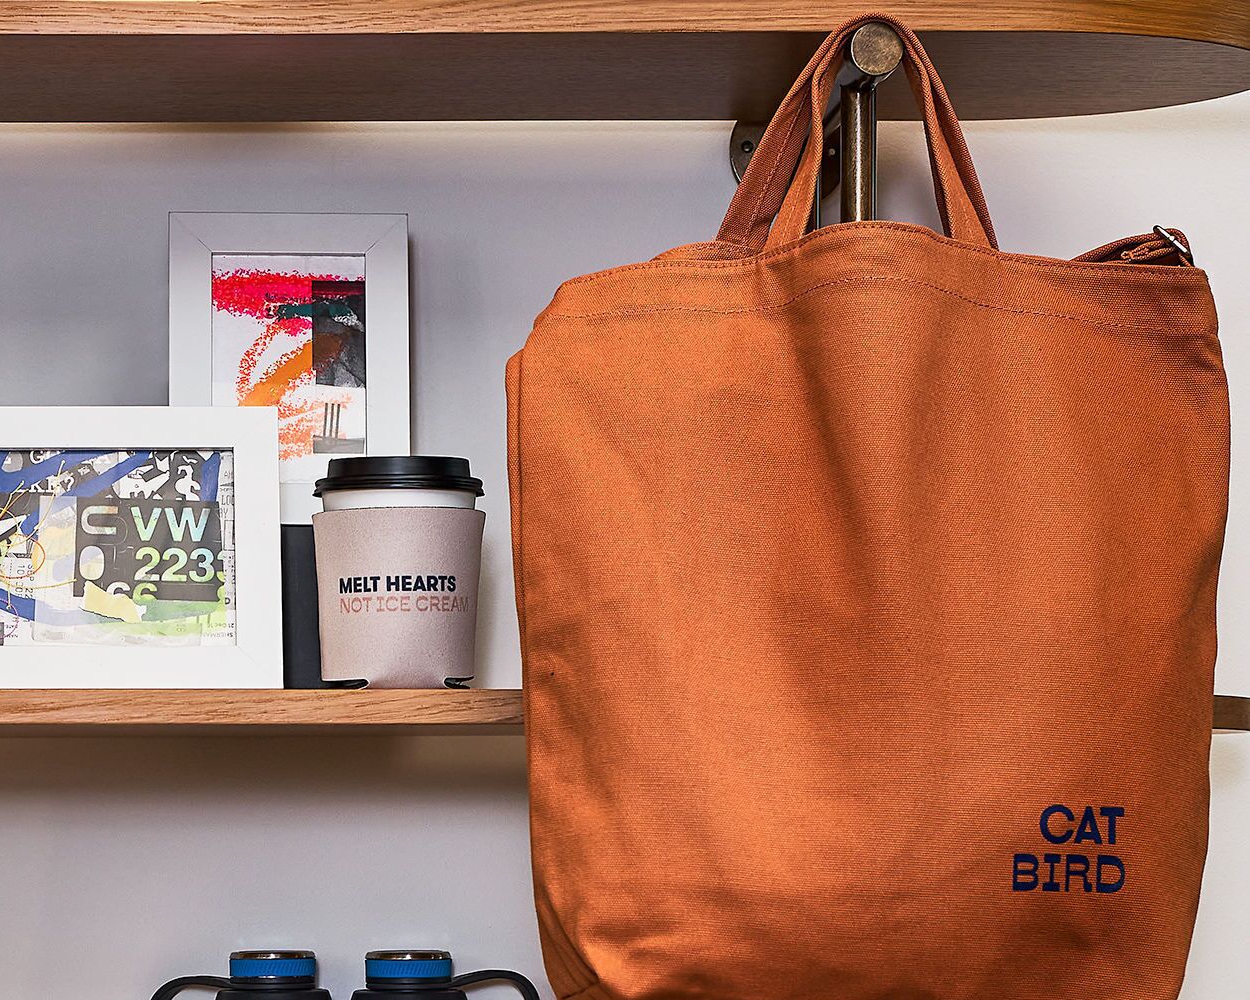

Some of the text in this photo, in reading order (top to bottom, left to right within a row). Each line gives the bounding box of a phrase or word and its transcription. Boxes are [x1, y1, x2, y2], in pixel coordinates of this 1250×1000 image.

[130, 506, 211, 542] VW
[339, 575, 457, 594] MELT HEARTS
[339, 595, 469, 614] NOT ICE CREAM
[1039, 804, 1125, 845] CAT
[1012, 853, 1126, 893] BIRD
